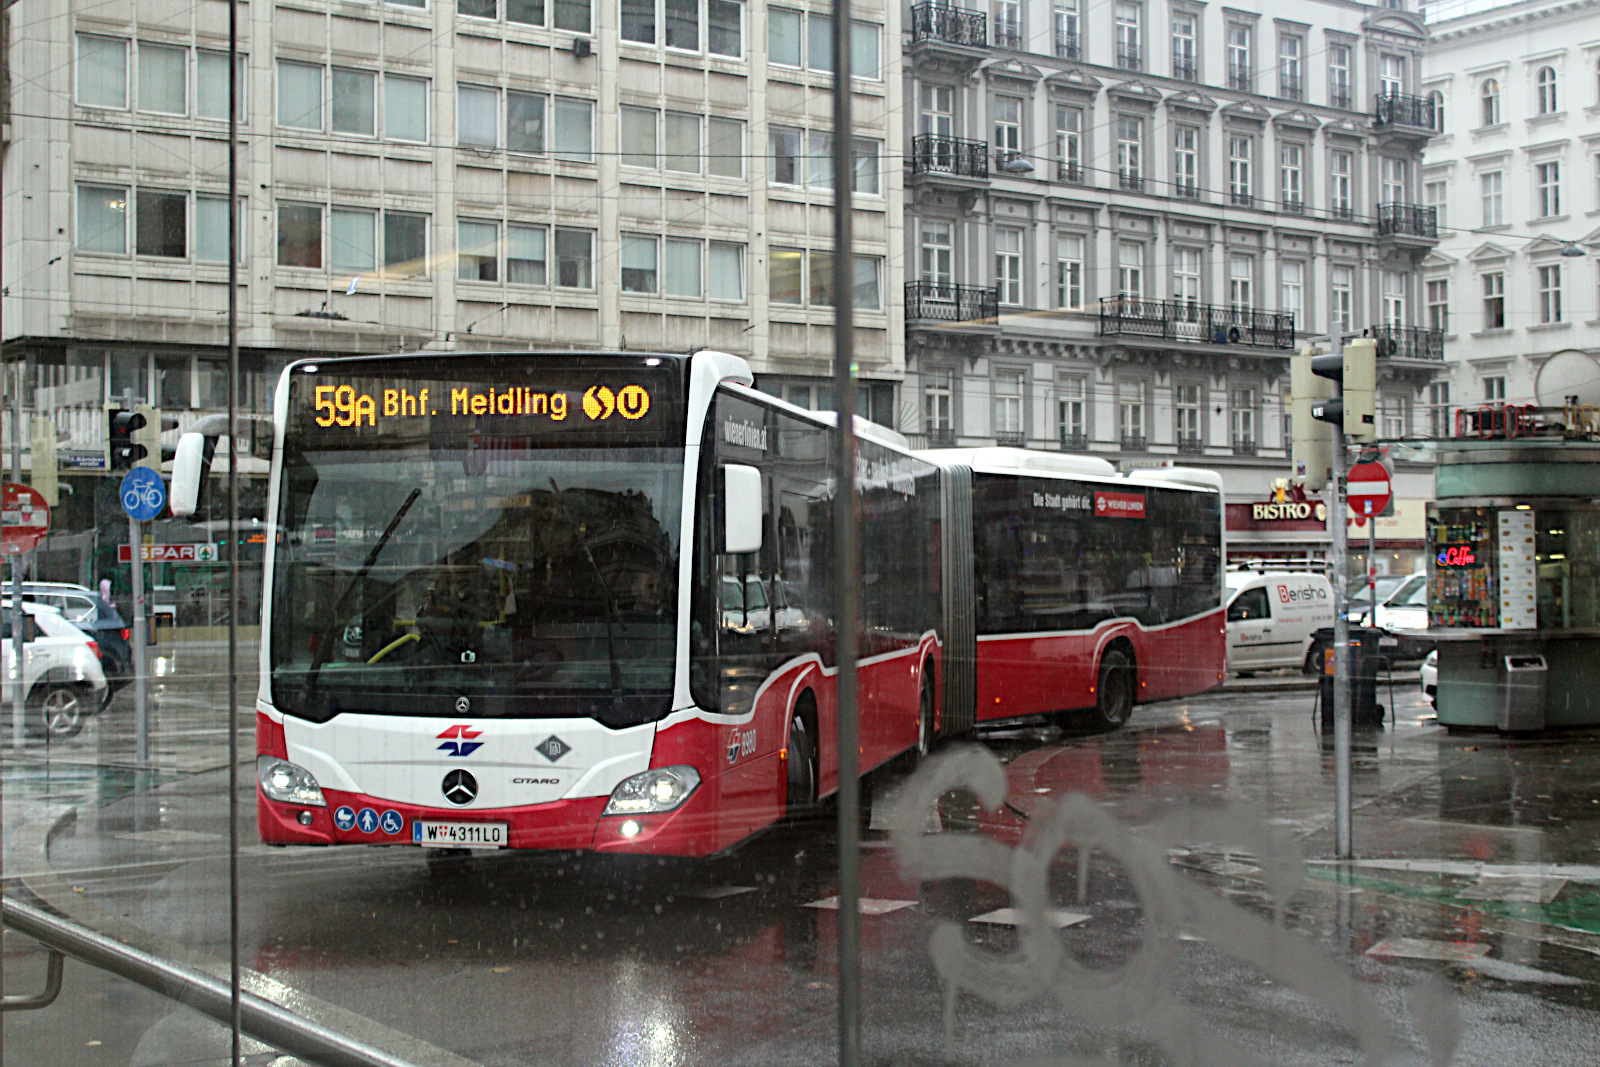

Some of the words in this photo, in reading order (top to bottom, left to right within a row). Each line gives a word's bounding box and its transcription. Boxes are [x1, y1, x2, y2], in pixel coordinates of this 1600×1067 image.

[315, 385, 376, 427] 59A
[384, 388, 437, 416] Bhf.
[451, 387, 568, 421] Meidling
[724, 415, 768, 451] wienerlinien.at
[1033, 492, 1044, 507] Die
[1045, 493, 1061, 508] Stadt
[1062, 494, 1081, 512] gehört
[1081, 495, 1092, 510] dir.
[1107, 499, 1127, 510] WIENER
[1127, 501, 1144, 511] LINIEN
[1253, 502, 1311, 520] BISTRO
[141, 546, 194, 559] SPAR
[1447, 546, 1476, 566] Coffee
[1277, 584, 1327, 603] Berisha
[741, 728, 757, 757] 8980
[512, 777, 560, 785] CITARO
[427, 825, 437, 840] W
